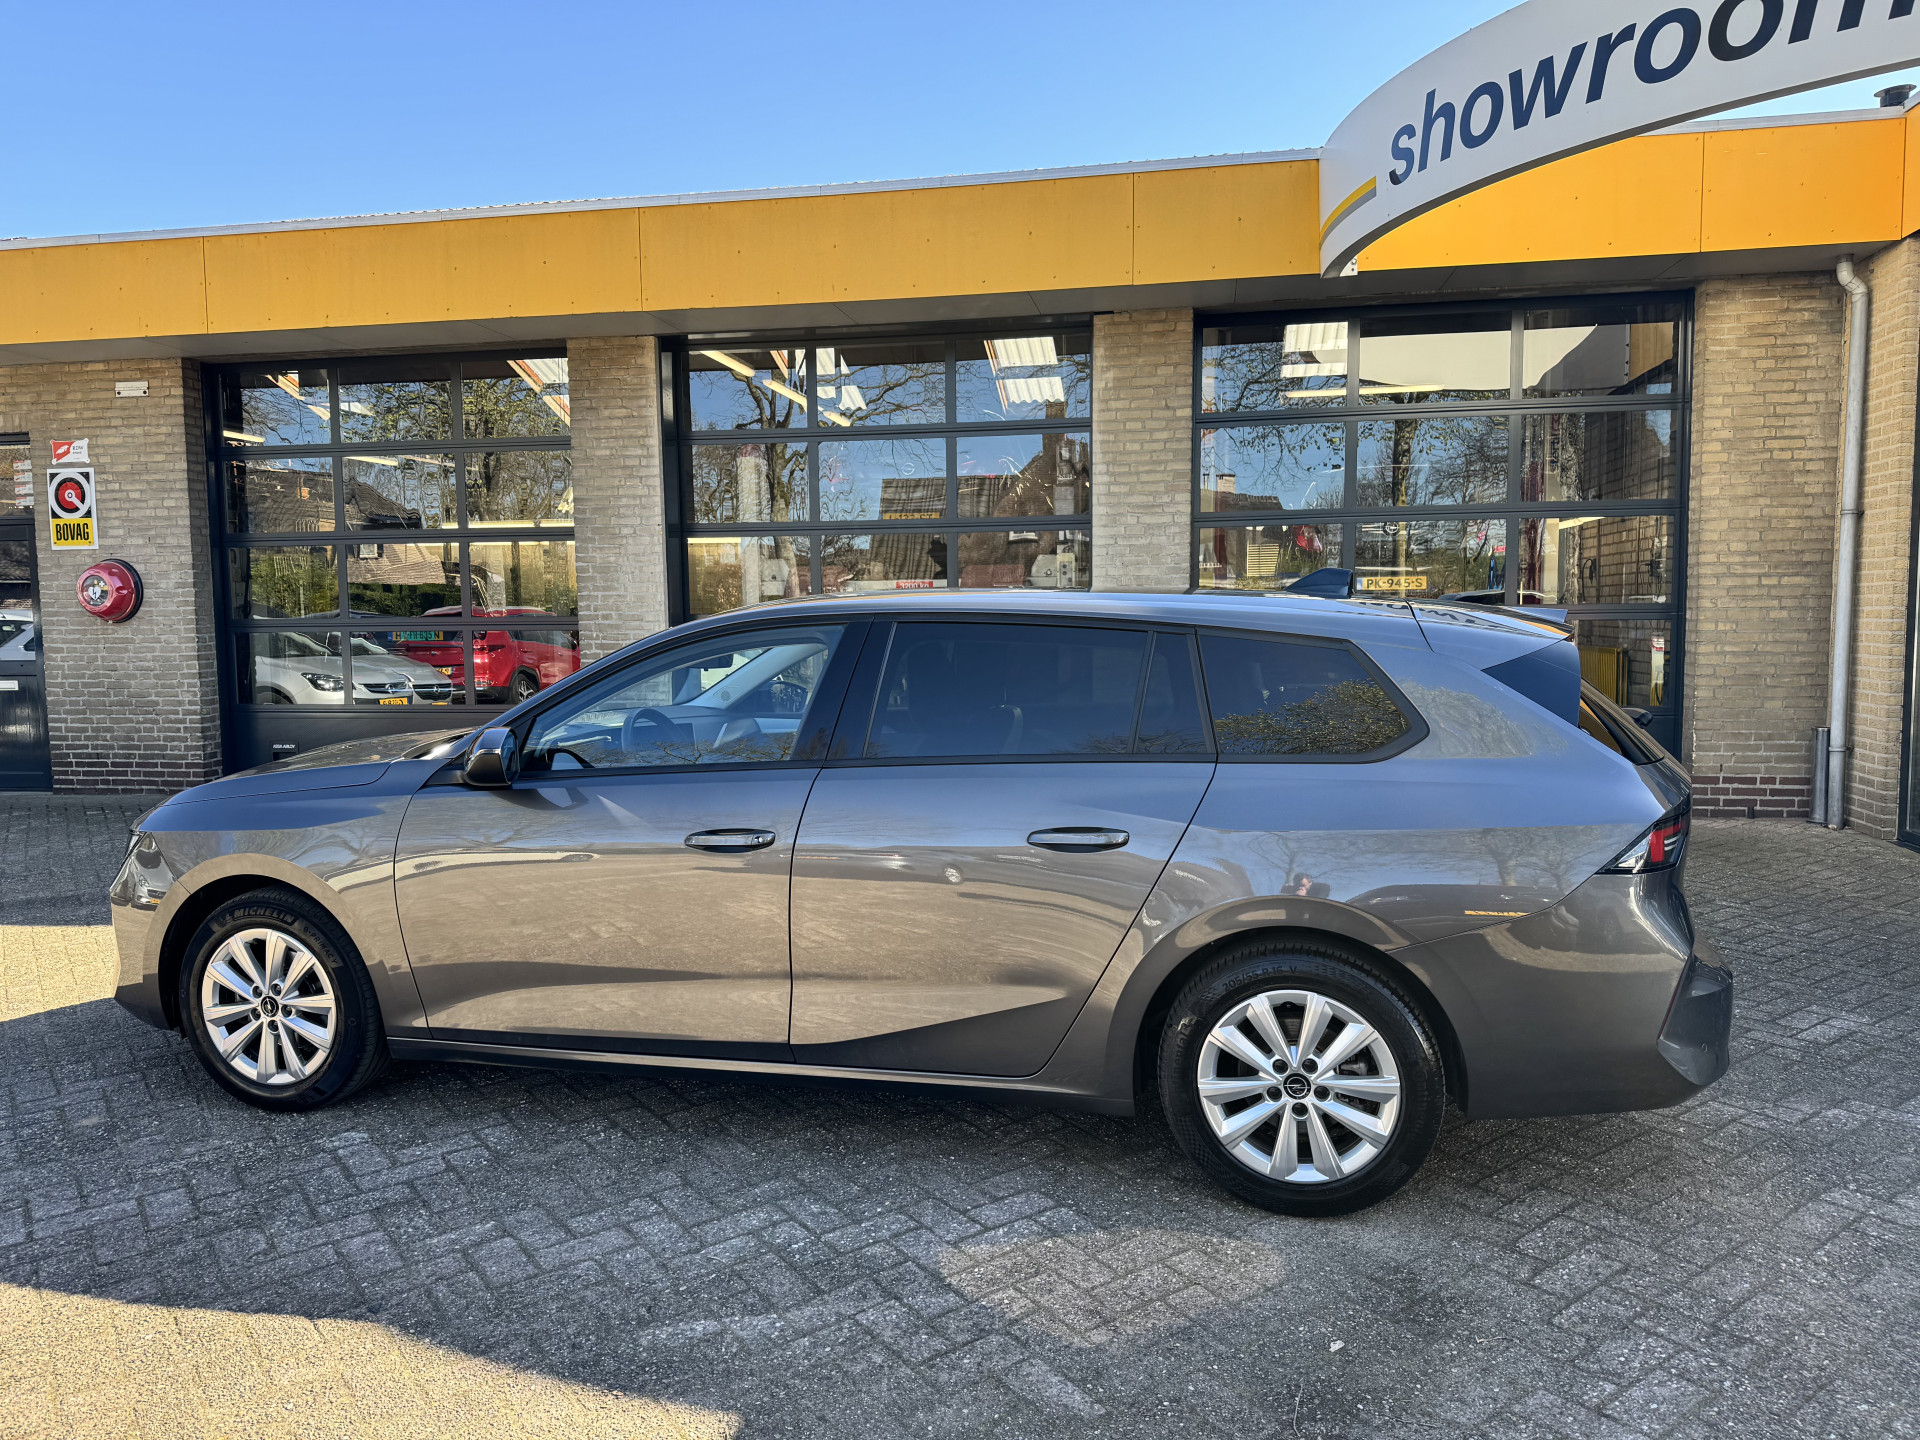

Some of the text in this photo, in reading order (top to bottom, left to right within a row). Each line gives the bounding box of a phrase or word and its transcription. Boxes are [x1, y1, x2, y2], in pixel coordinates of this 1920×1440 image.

[55, 523, 89, 541] BOVAG
[234, 907, 295, 923] MICHELIN
[1223, 971, 1258, 991] 205/55
